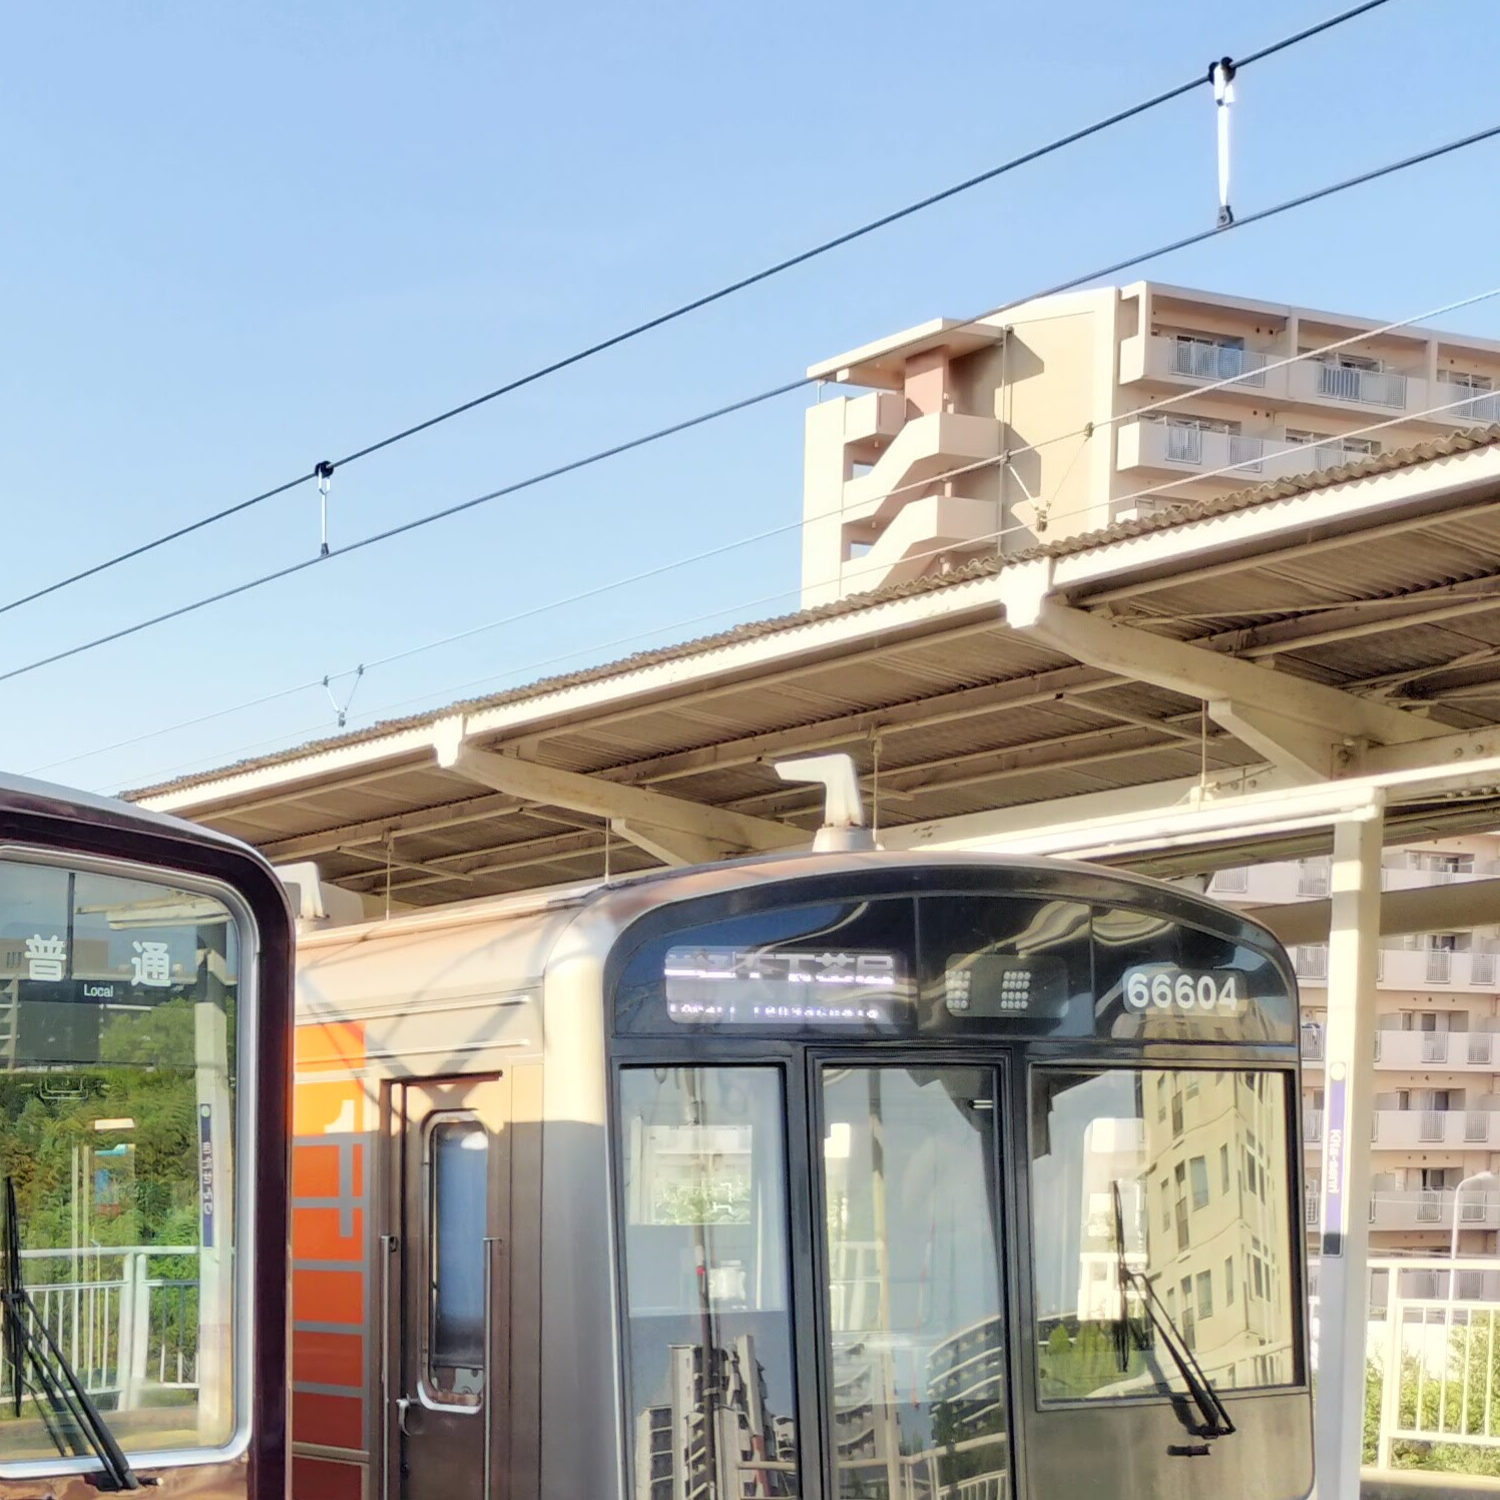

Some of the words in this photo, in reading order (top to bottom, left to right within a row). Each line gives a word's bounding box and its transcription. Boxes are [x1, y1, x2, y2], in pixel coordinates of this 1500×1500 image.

[24, 934, 171, 987] 普通
[83, 983, 114, 998] Local
[1127, 972, 1238, 1011] 66604
